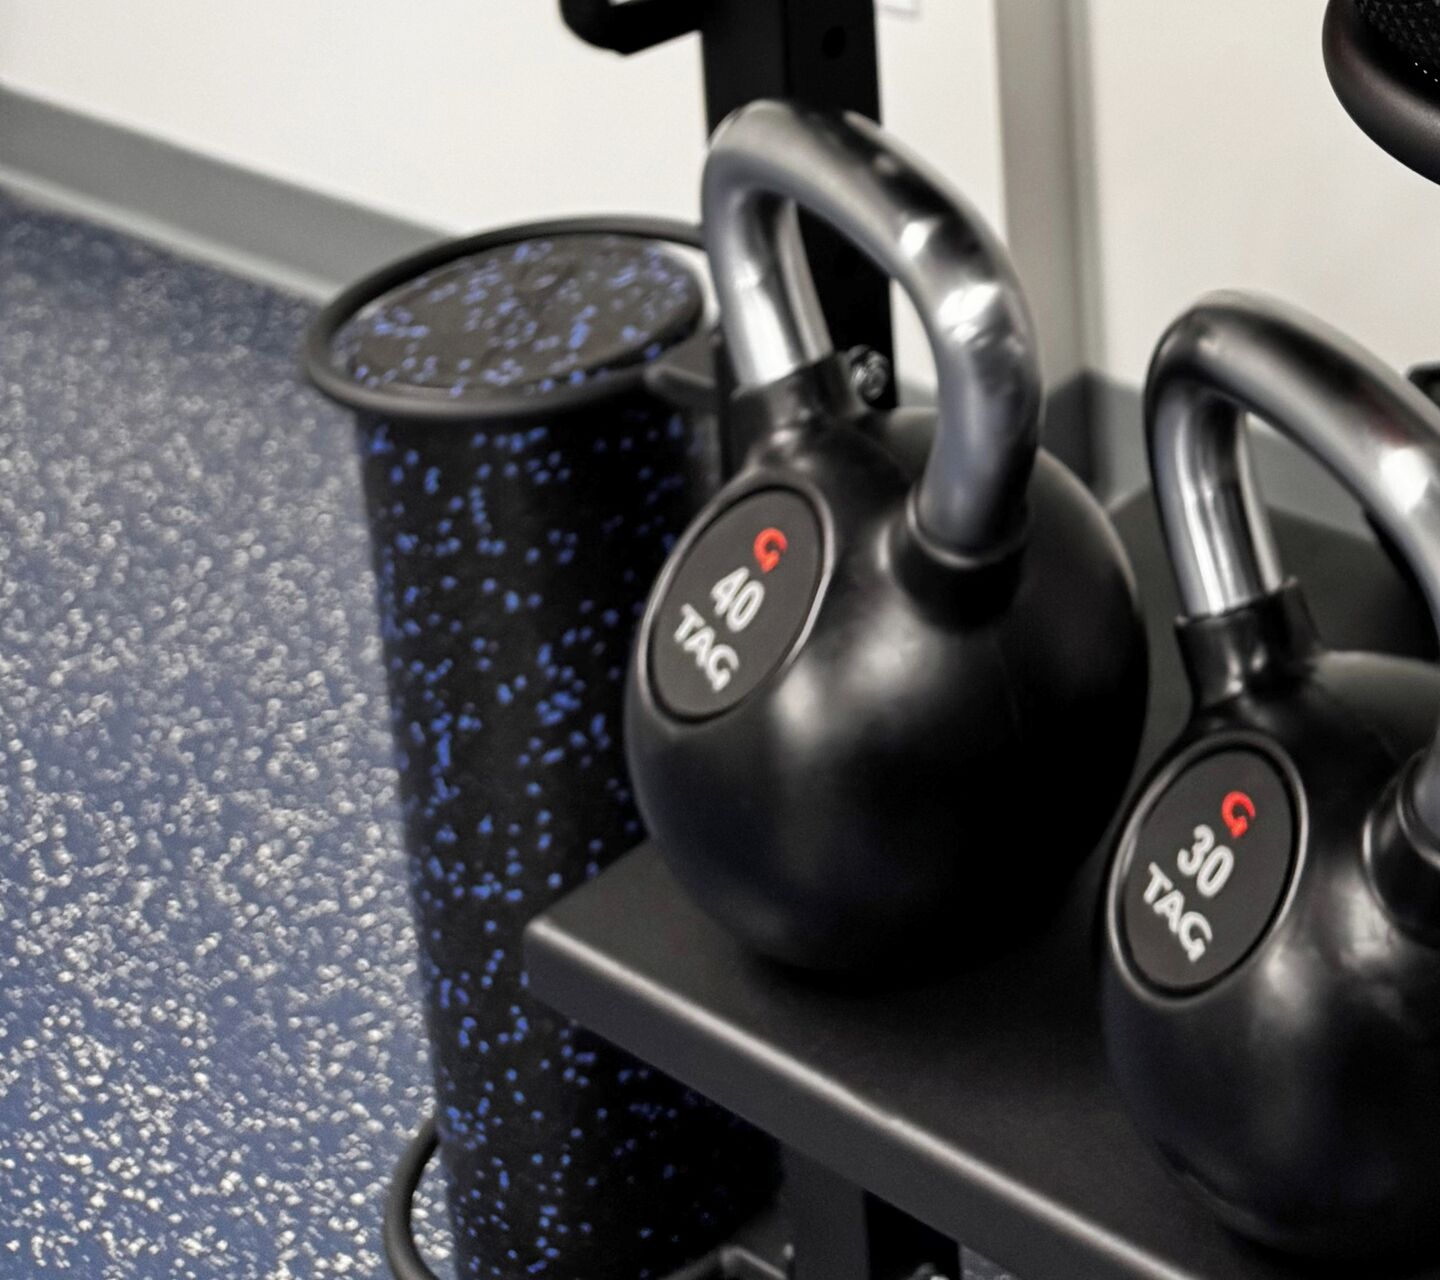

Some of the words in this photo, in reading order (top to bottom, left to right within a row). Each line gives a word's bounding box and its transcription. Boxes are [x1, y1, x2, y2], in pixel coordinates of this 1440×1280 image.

[710, 566, 766, 633] 40
[674, 603, 740, 692] TAG
[1177, 824, 1235, 897] 30
[1143, 861, 1214, 963] TAG
